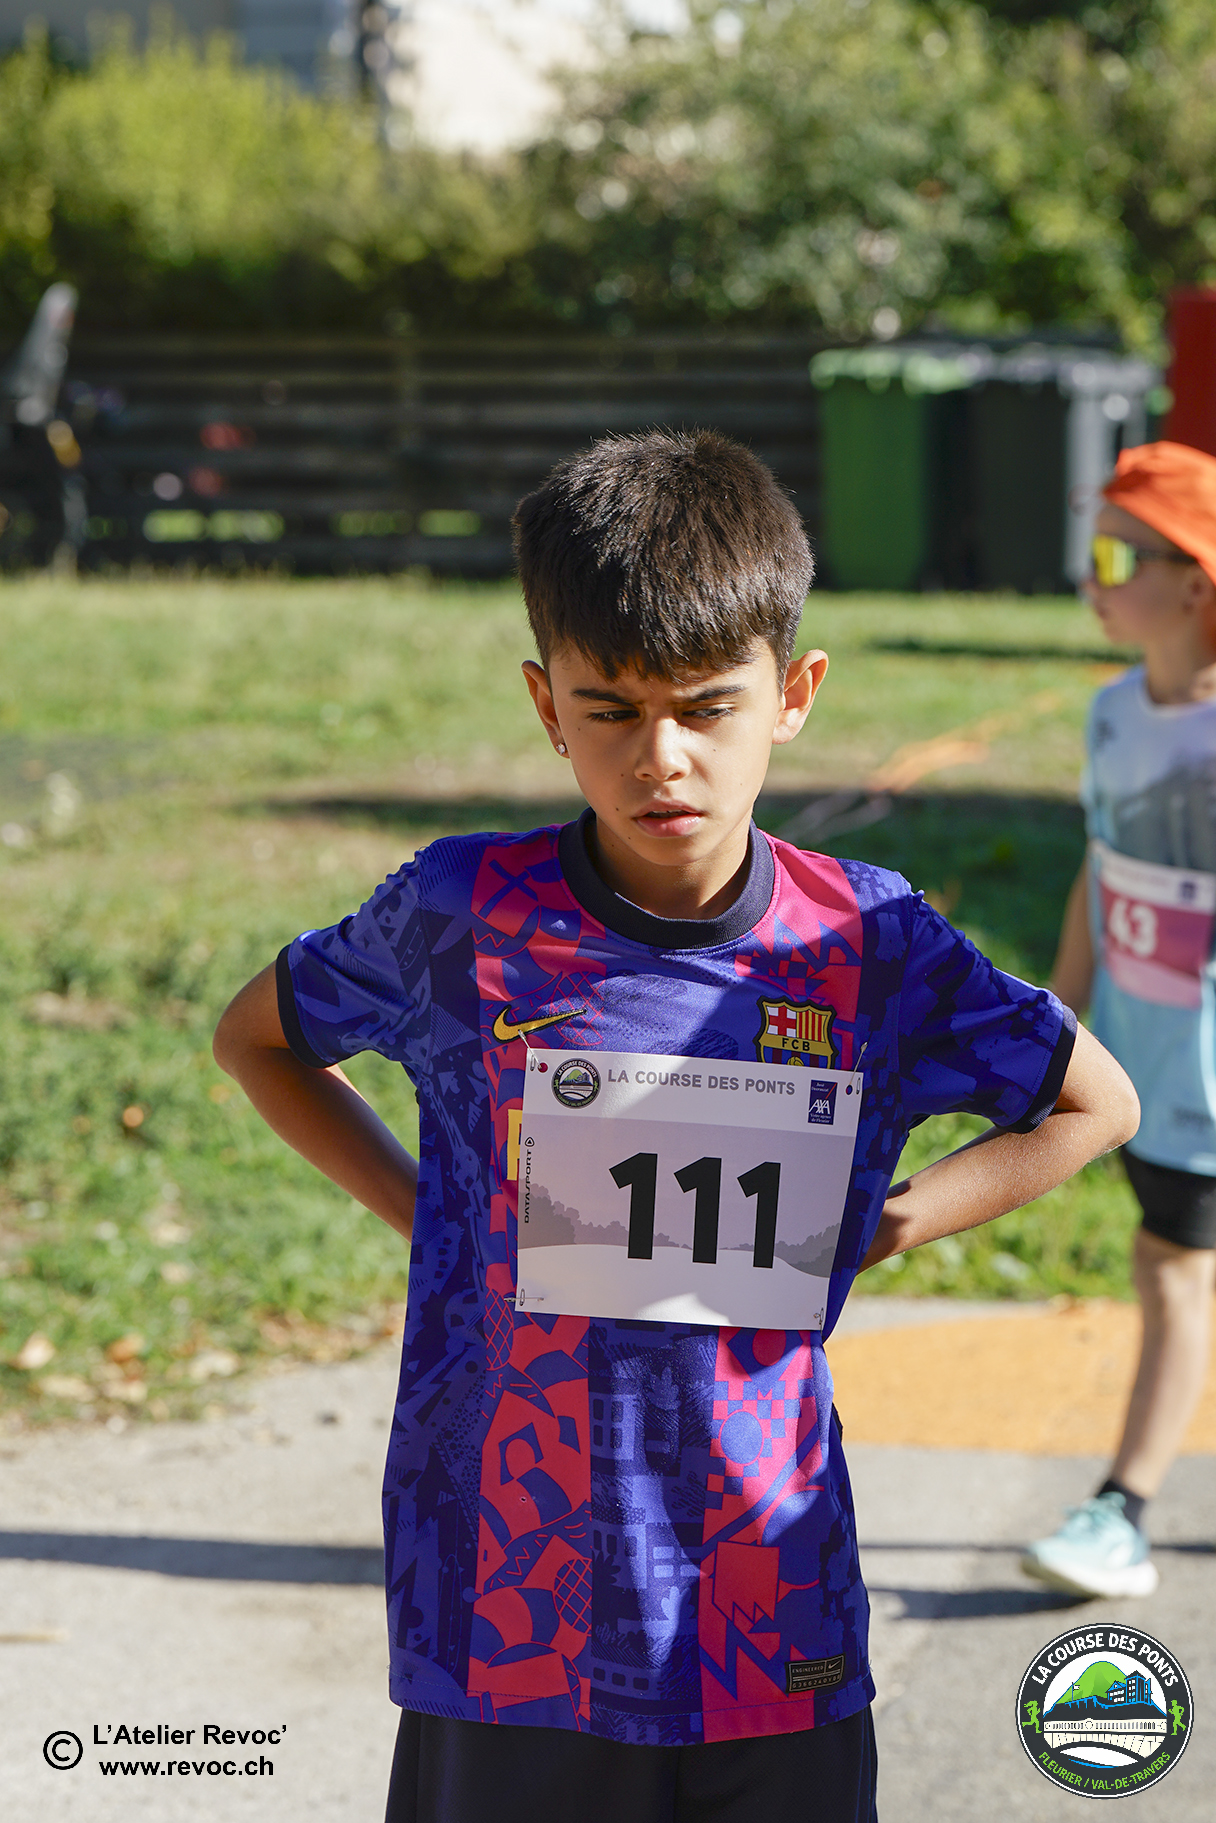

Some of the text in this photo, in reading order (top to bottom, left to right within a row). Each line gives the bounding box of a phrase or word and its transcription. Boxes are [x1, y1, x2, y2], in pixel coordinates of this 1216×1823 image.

[1109, 899, 1157, 958] 43
[782, 1038, 810, 1051] FCB
[608, 1069, 629, 1083] LA
[635, 1071, 701, 1088] COURSE
[708, 1075, 739, 1091] DES
[745, 1078, 795, 1096] PONTS
[808, 1099, 831, 1115] AXA
[524, 1149, 532, 1223] DATASPORT
[609, 1152, 781, 1269] 111
